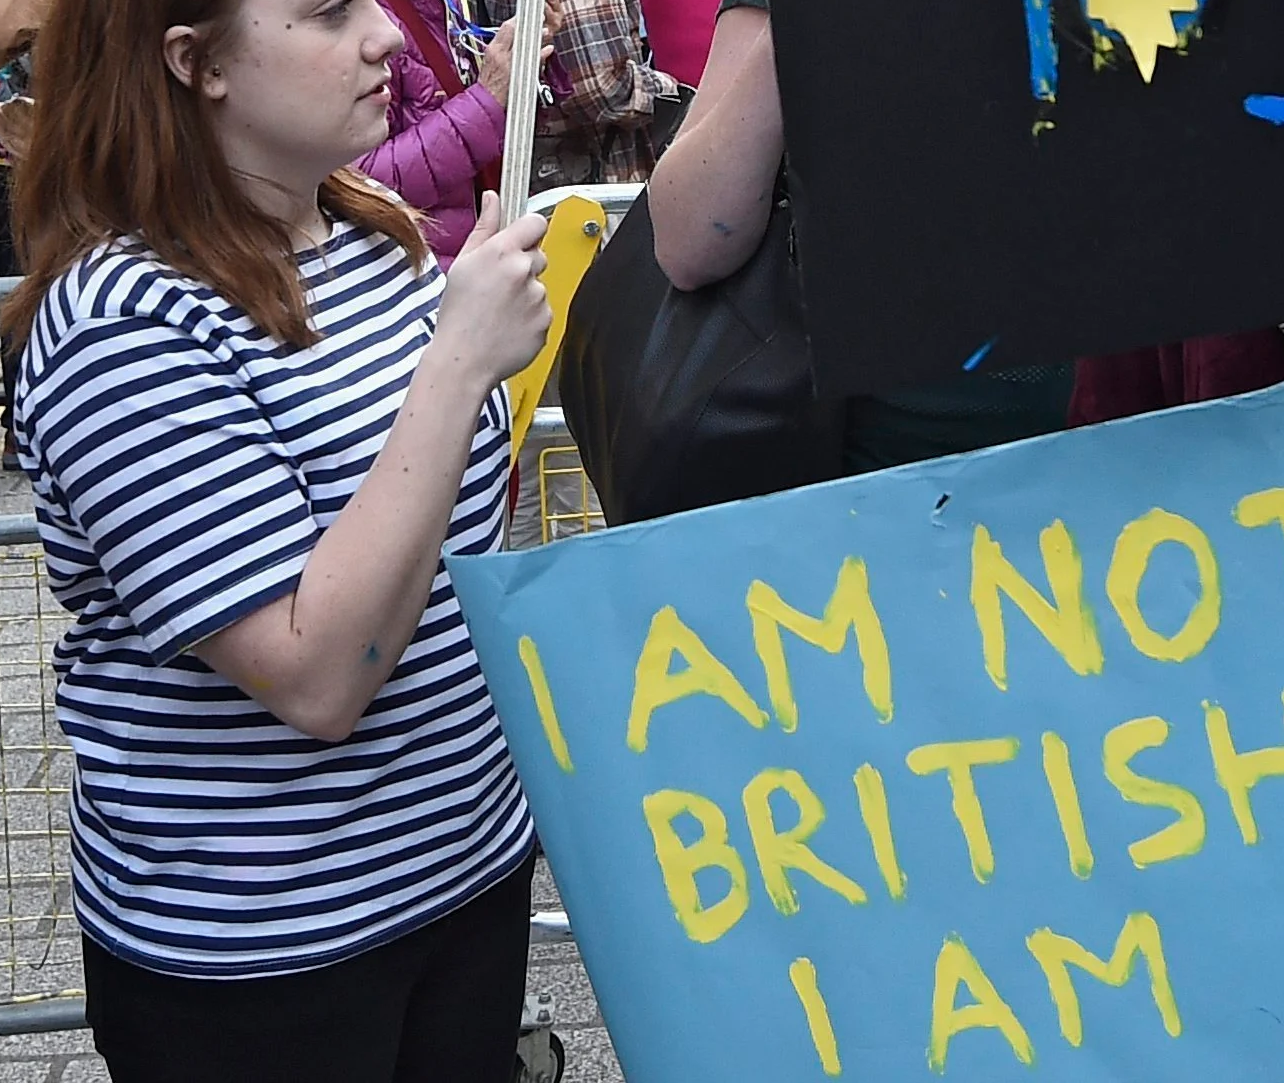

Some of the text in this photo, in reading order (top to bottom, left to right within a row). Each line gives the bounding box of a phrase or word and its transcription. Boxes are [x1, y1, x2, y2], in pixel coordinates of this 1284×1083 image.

[519, 635, 570, 774] I
[626, 556, 894, 753] AM
[789, 912, 1182, 1076] I AM
